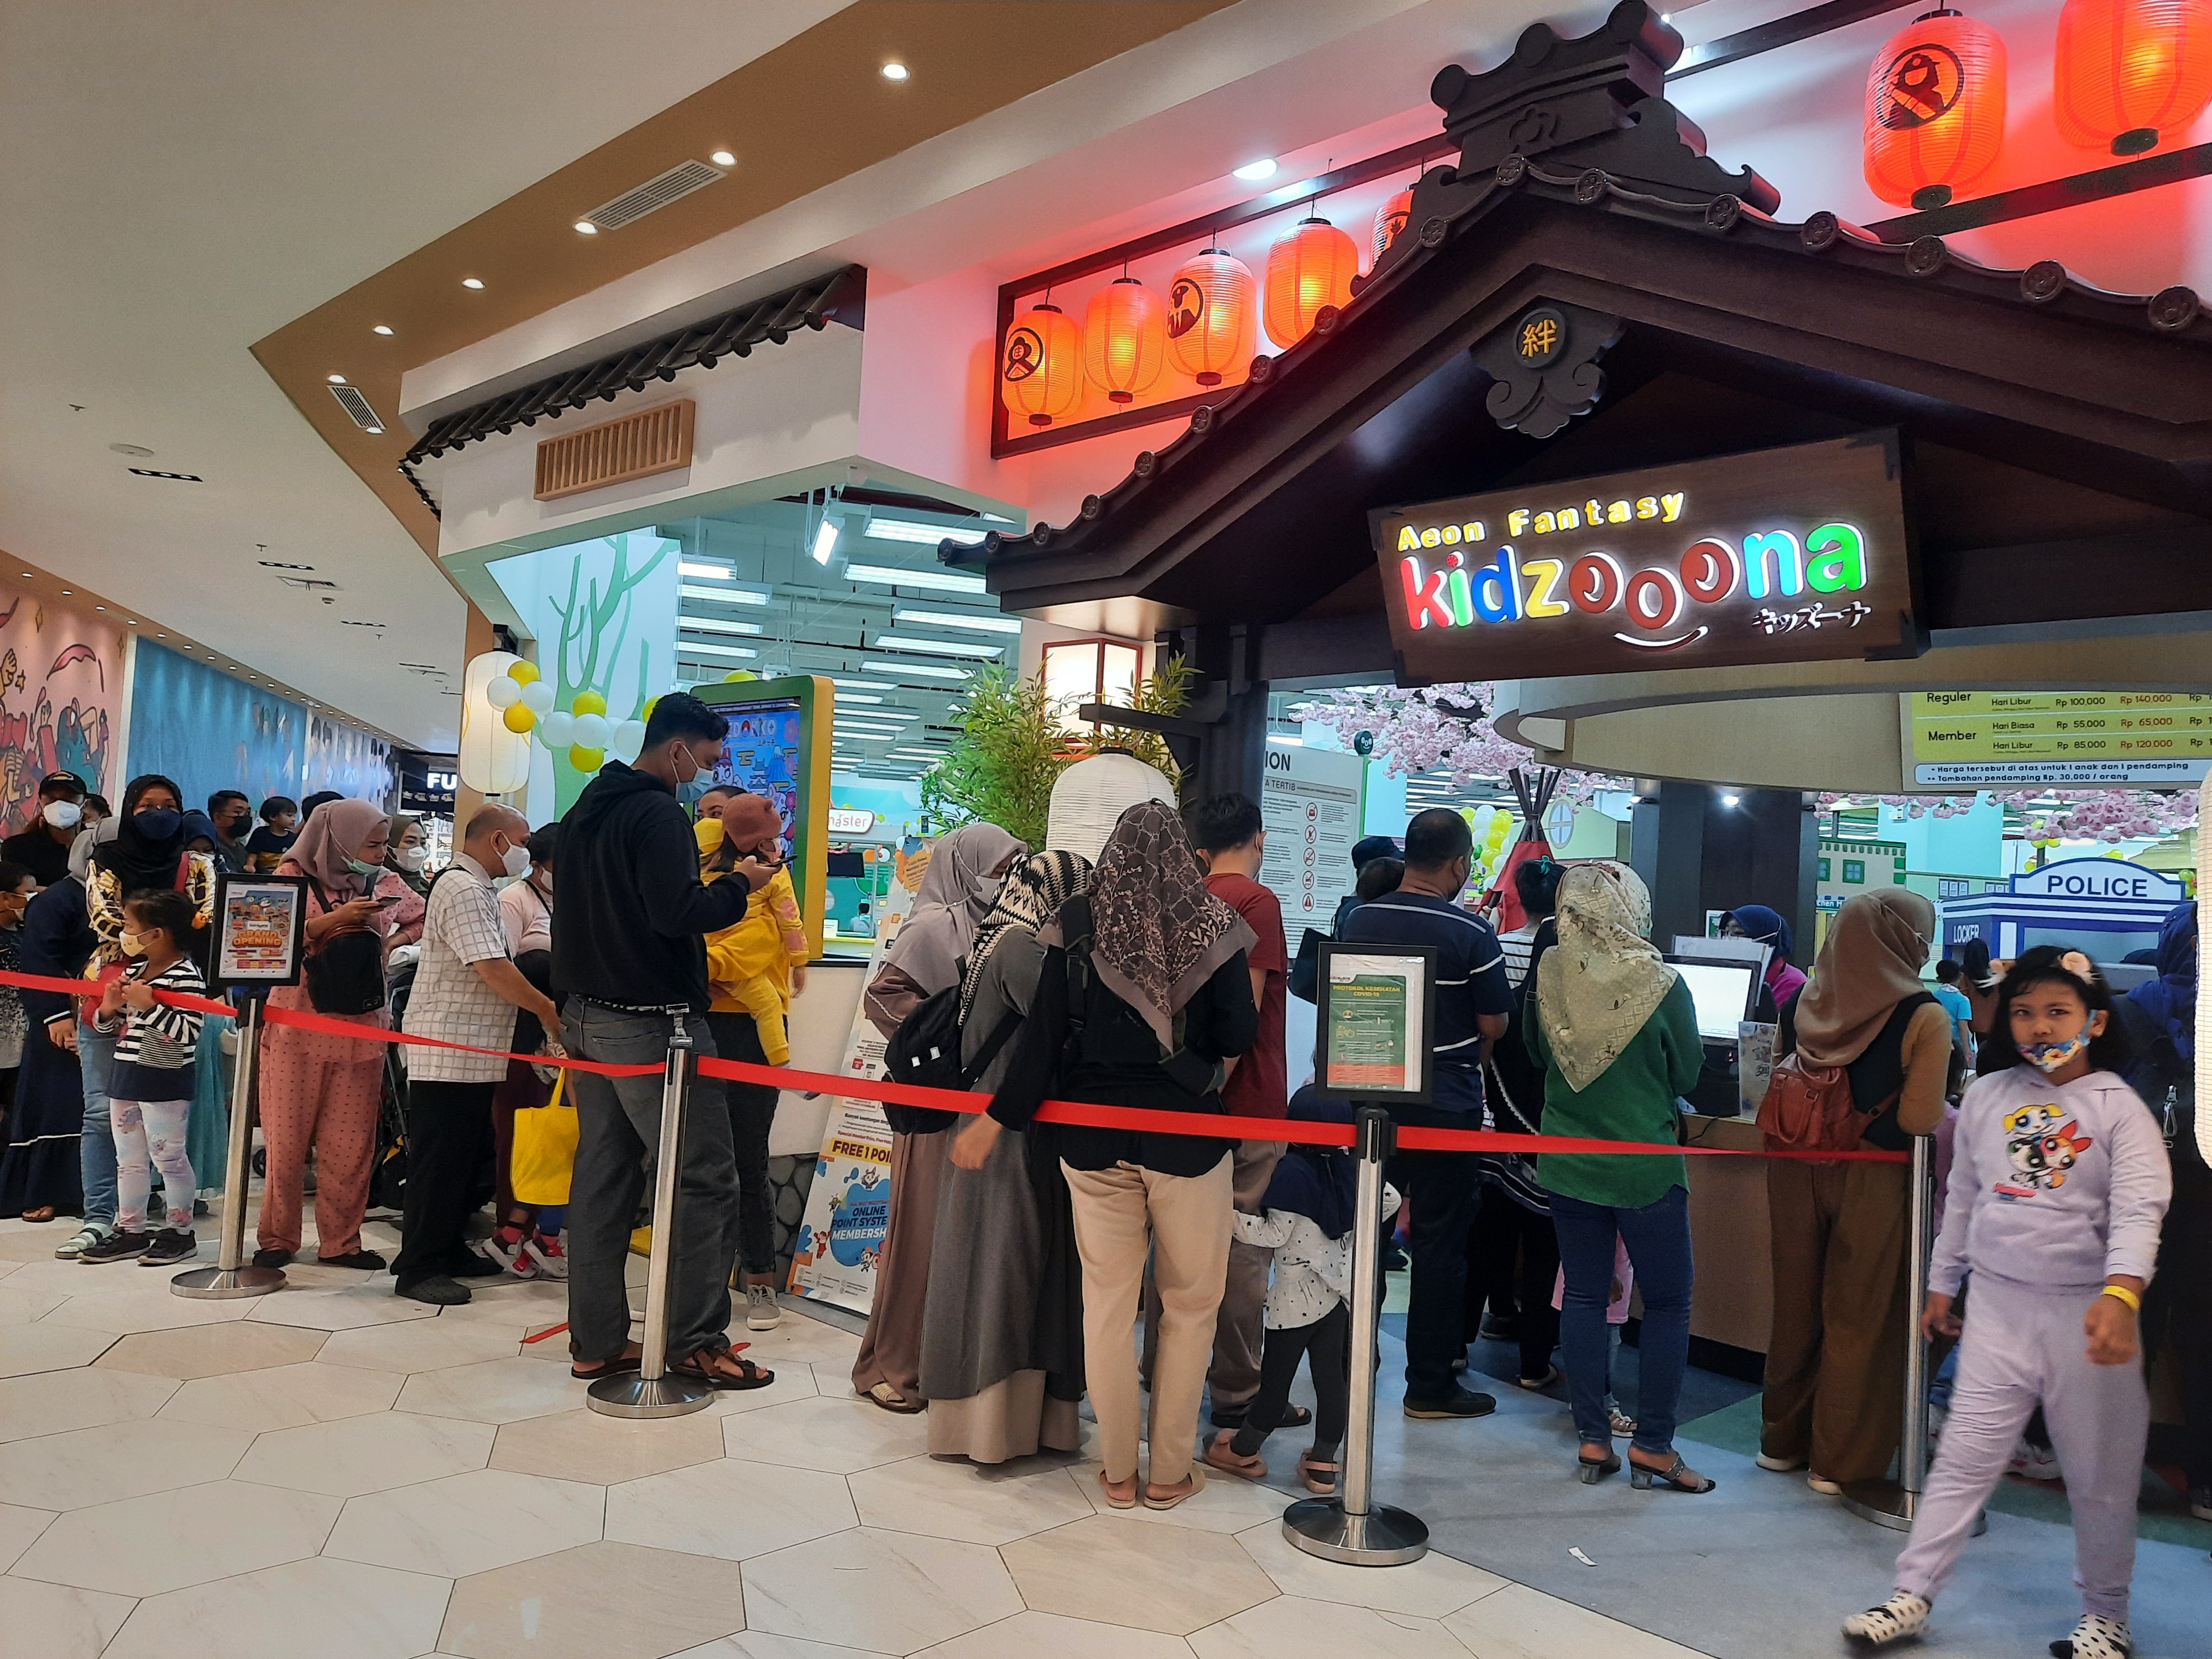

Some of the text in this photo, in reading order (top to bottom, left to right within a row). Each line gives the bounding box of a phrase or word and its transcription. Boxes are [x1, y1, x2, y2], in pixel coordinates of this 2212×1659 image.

[1521, 318, 1558, 358] 絆
[1397, 492, 1684, 552] Aeon Fantasy
[1399, 522, 1869, 631] kidzooona
[1752, 601, 1872, 635] キッズーナ
[1927, 692, 1971, 705] Reguler
[2056, 699, 2067, 708] Rp
[2121, 696, 2132, 705] Rp
[2189, 693, 2202, 703] Rp
[2057, 721, 2068, 730] Rp
[2121, 719, 2133, 728] Rp
[2189, 717, 2202, 726] Rp
[1928, 731, 1976, 740] Member
[2057, 742, 2068, 750] Rp
[2121, 741, 2132, 750] Rp
[2190, 738, 2203, 748] Rp
[1271, 780, 1296, 791] TERTIB
[2048, 875, 2148, 897] POLICE
[238, 930, 278, 938] GRAND
[1953, 924, 1980, 944] LOCKER
[233, 937, 281, 946] OPENING
[832, 1140, 864, 1157] FREE
[865, 1146, 869, 1159] 1
[853, 1206, 886, 1217] ONLINE
[832, 1218, 858, 1227] POINT
